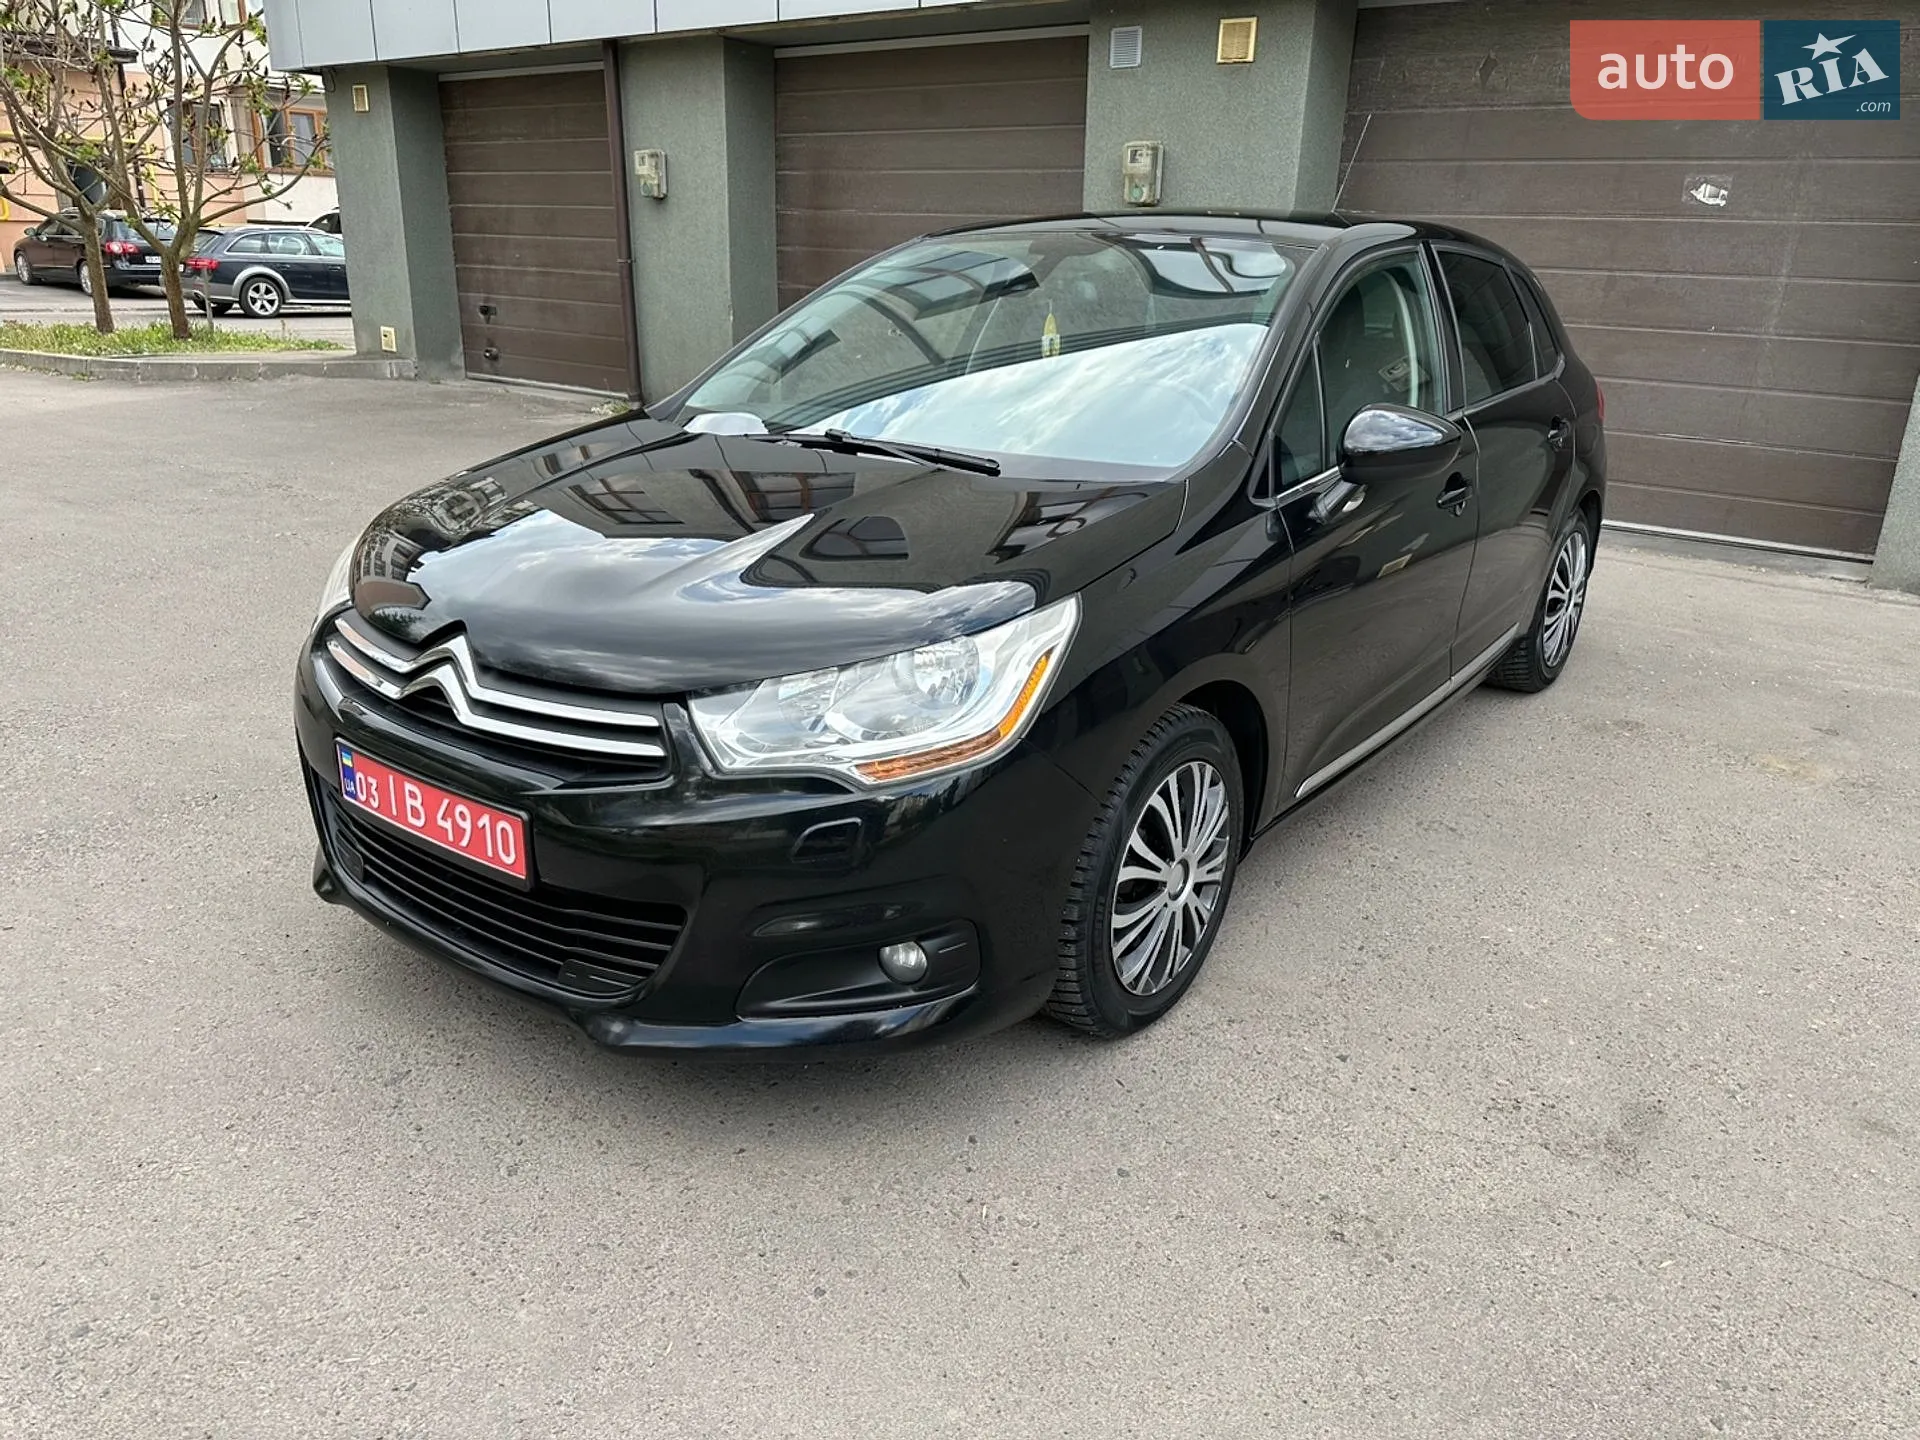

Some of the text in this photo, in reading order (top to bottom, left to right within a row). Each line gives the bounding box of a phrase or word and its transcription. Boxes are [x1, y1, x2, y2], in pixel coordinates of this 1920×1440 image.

[345, 779, 355, 794] UA
[355, 771, 379, 808] 03
[436, 798, 516, 865] 4910
